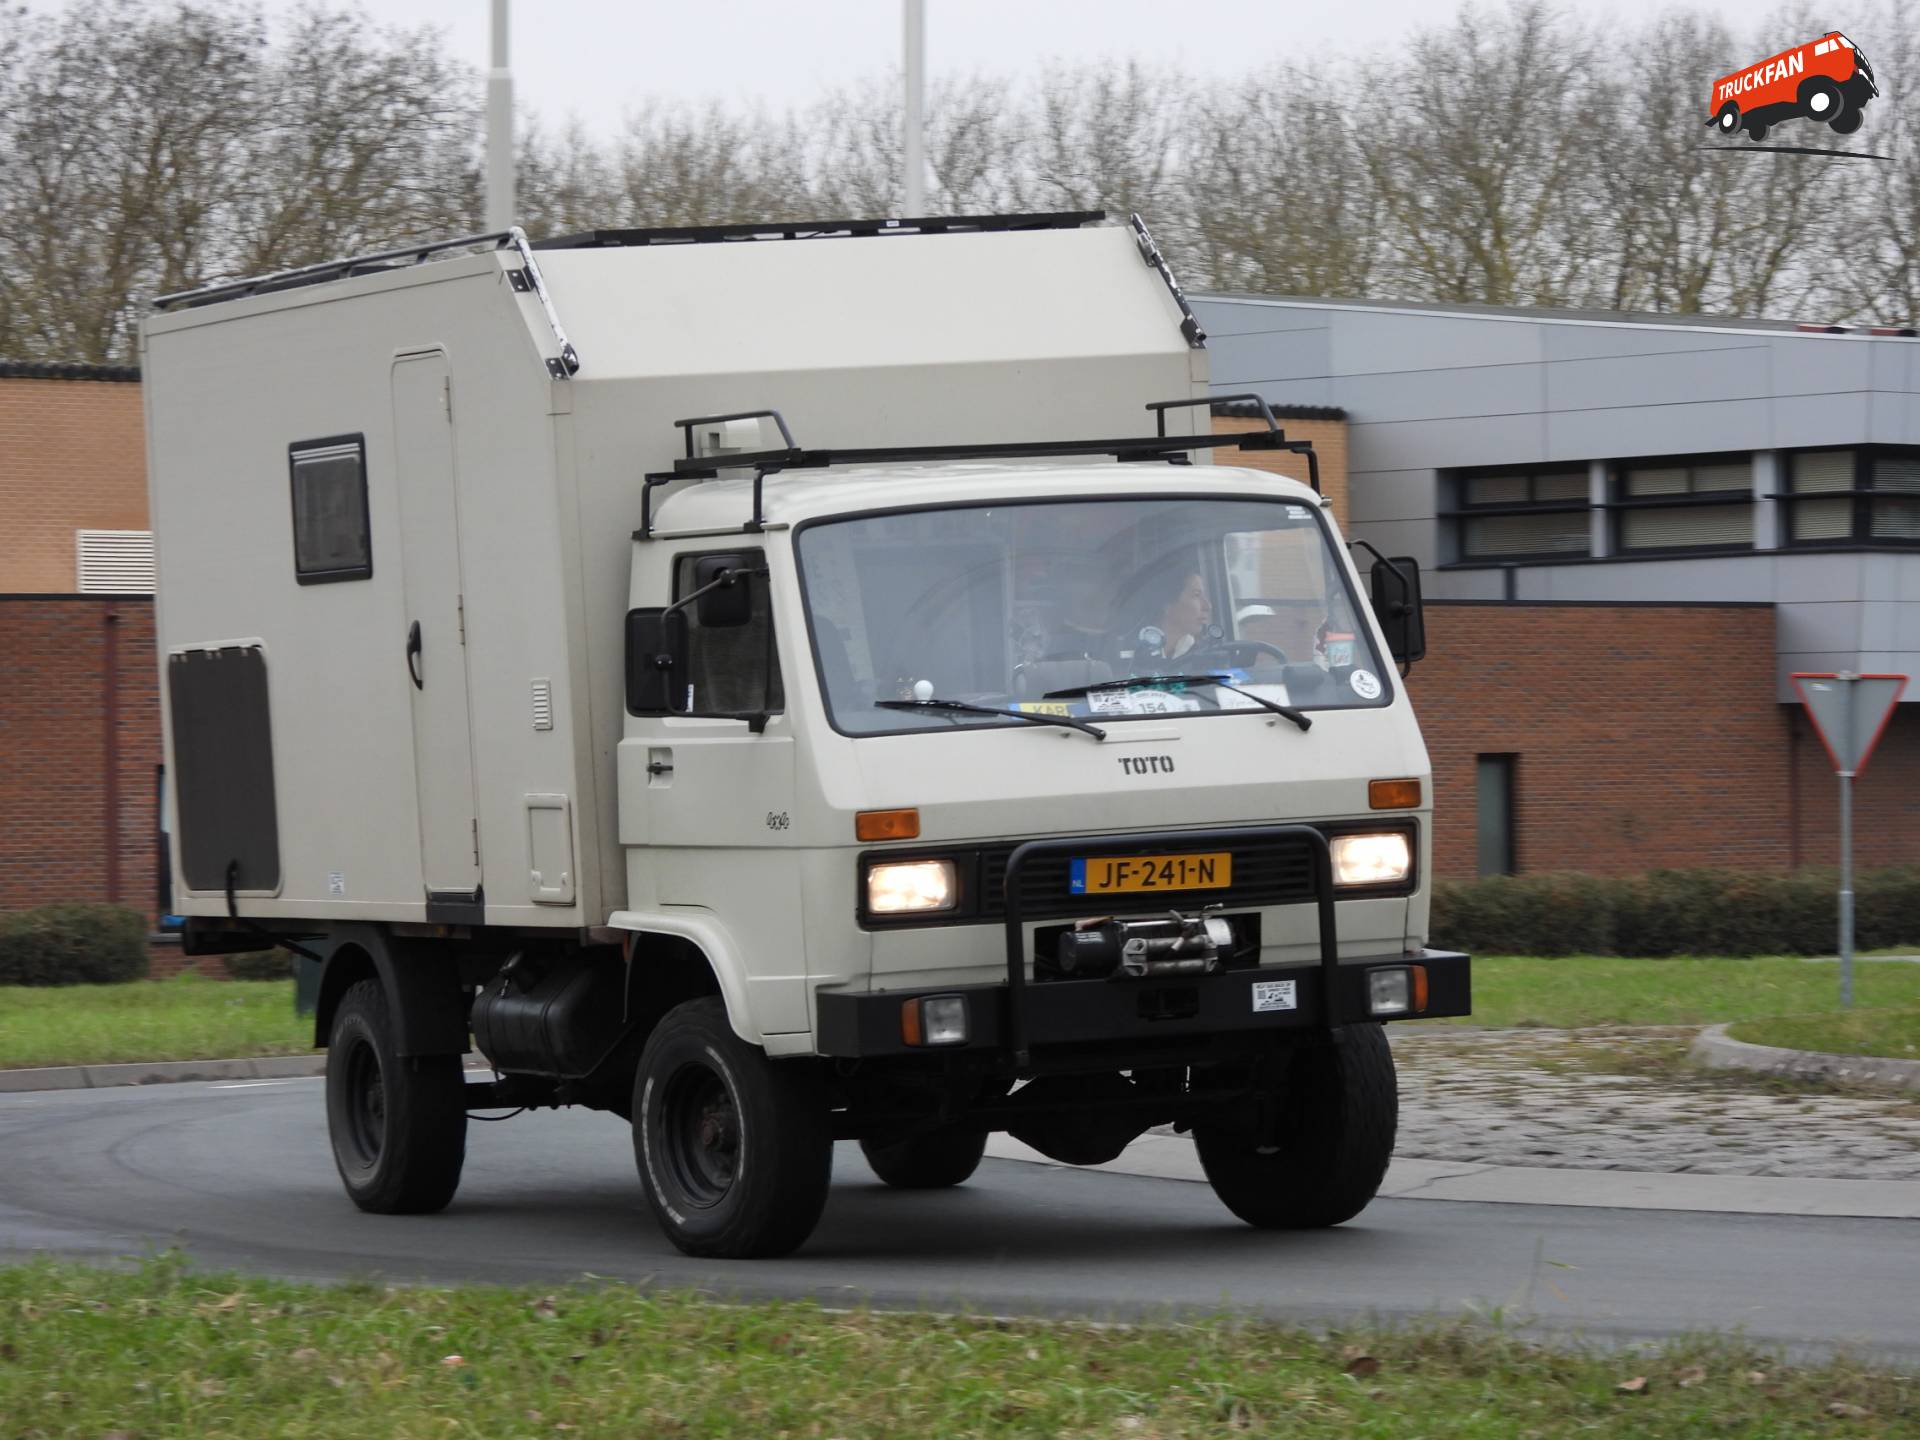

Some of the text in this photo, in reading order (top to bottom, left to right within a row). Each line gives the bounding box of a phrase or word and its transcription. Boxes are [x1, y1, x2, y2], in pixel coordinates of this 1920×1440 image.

[1139, 703, 1167, 714] 154
[1118, 755, 1175, 775] TOTO
[1099, 858, 1215, 888] JF-241-N
[1072, 879, 1085, 888] NL
